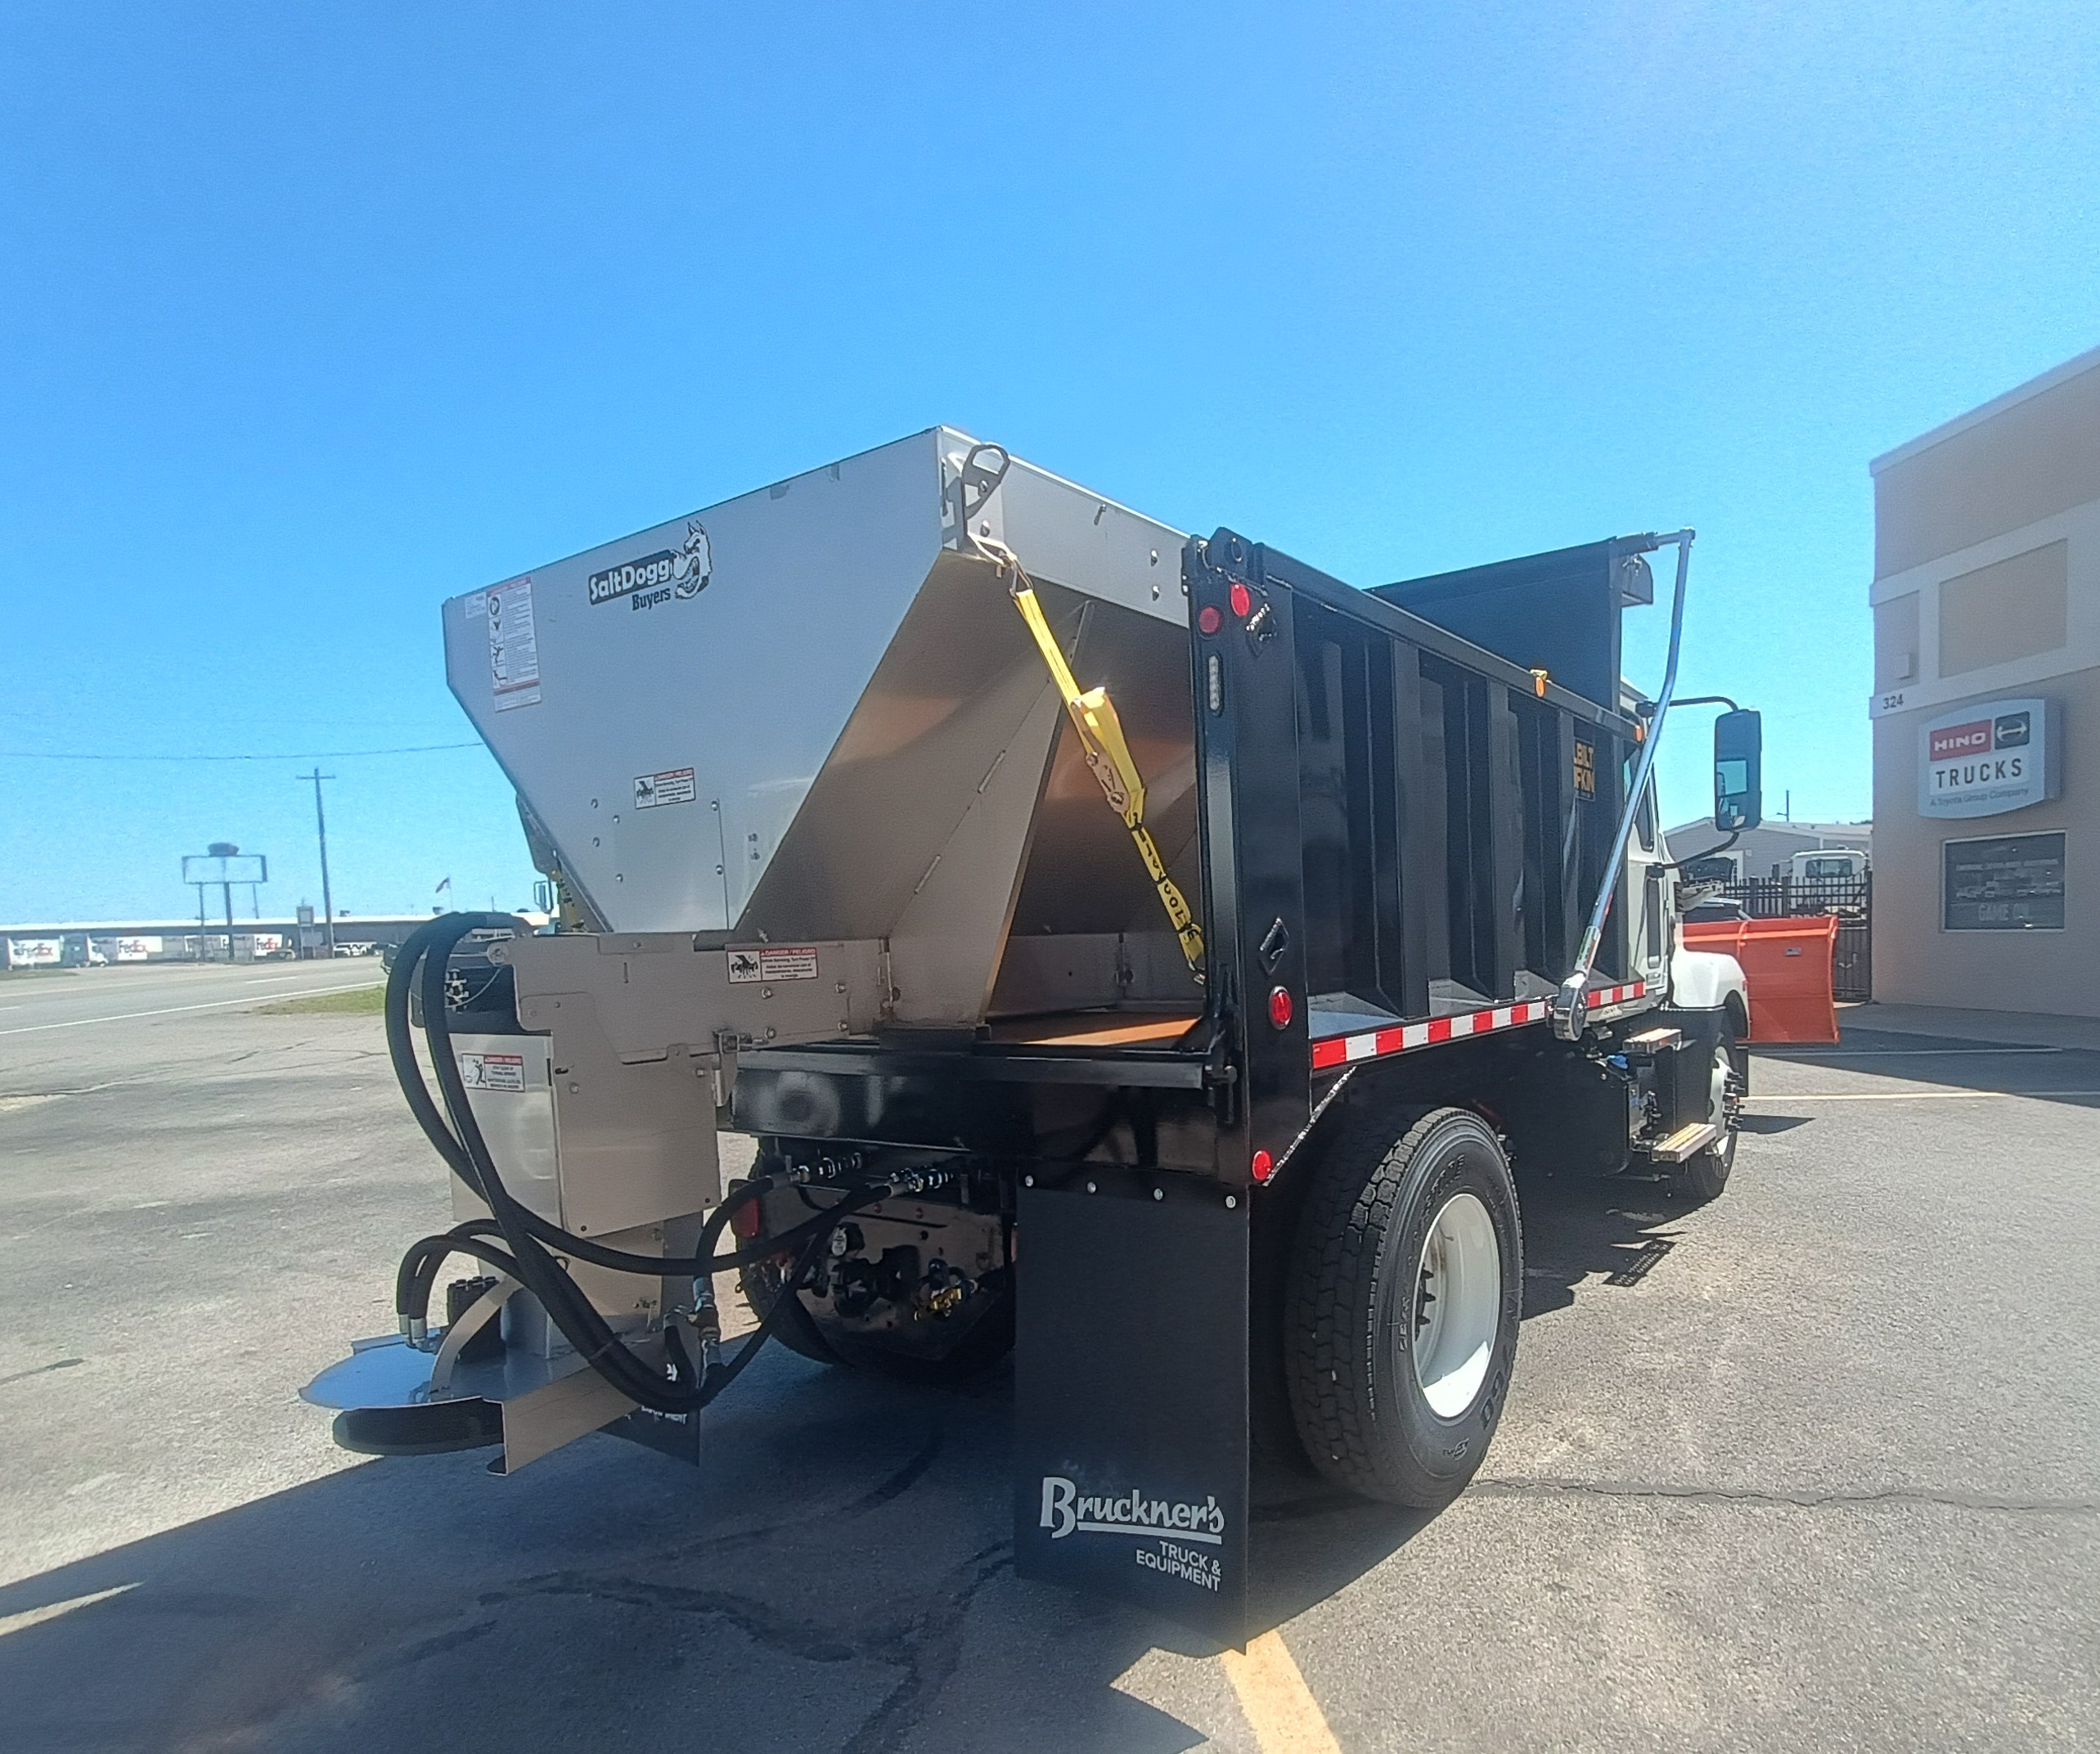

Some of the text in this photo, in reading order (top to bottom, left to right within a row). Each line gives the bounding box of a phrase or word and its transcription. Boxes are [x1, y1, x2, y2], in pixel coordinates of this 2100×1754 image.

[590, 559, 671, 601] SaltDogg
[632, 587, 671, 611] Buyers
[1883, 694, 1904, 710] 324
[1933, 732, 1986, 752] HINO
[1936, 758, 2022, 789] TRUCKS
[1930, 788, 2029, 807] A Toyota Group Company
[119, 940, 146, 955] FedEx
[256, 938, 279, 951] FedEx
[1040, 1476, 1225, 1539] Bruckner's
[1158, 1540, 1221, 1576] TRUCK &
[1135, 1549, 1221, 1592] EQUIPMENT
